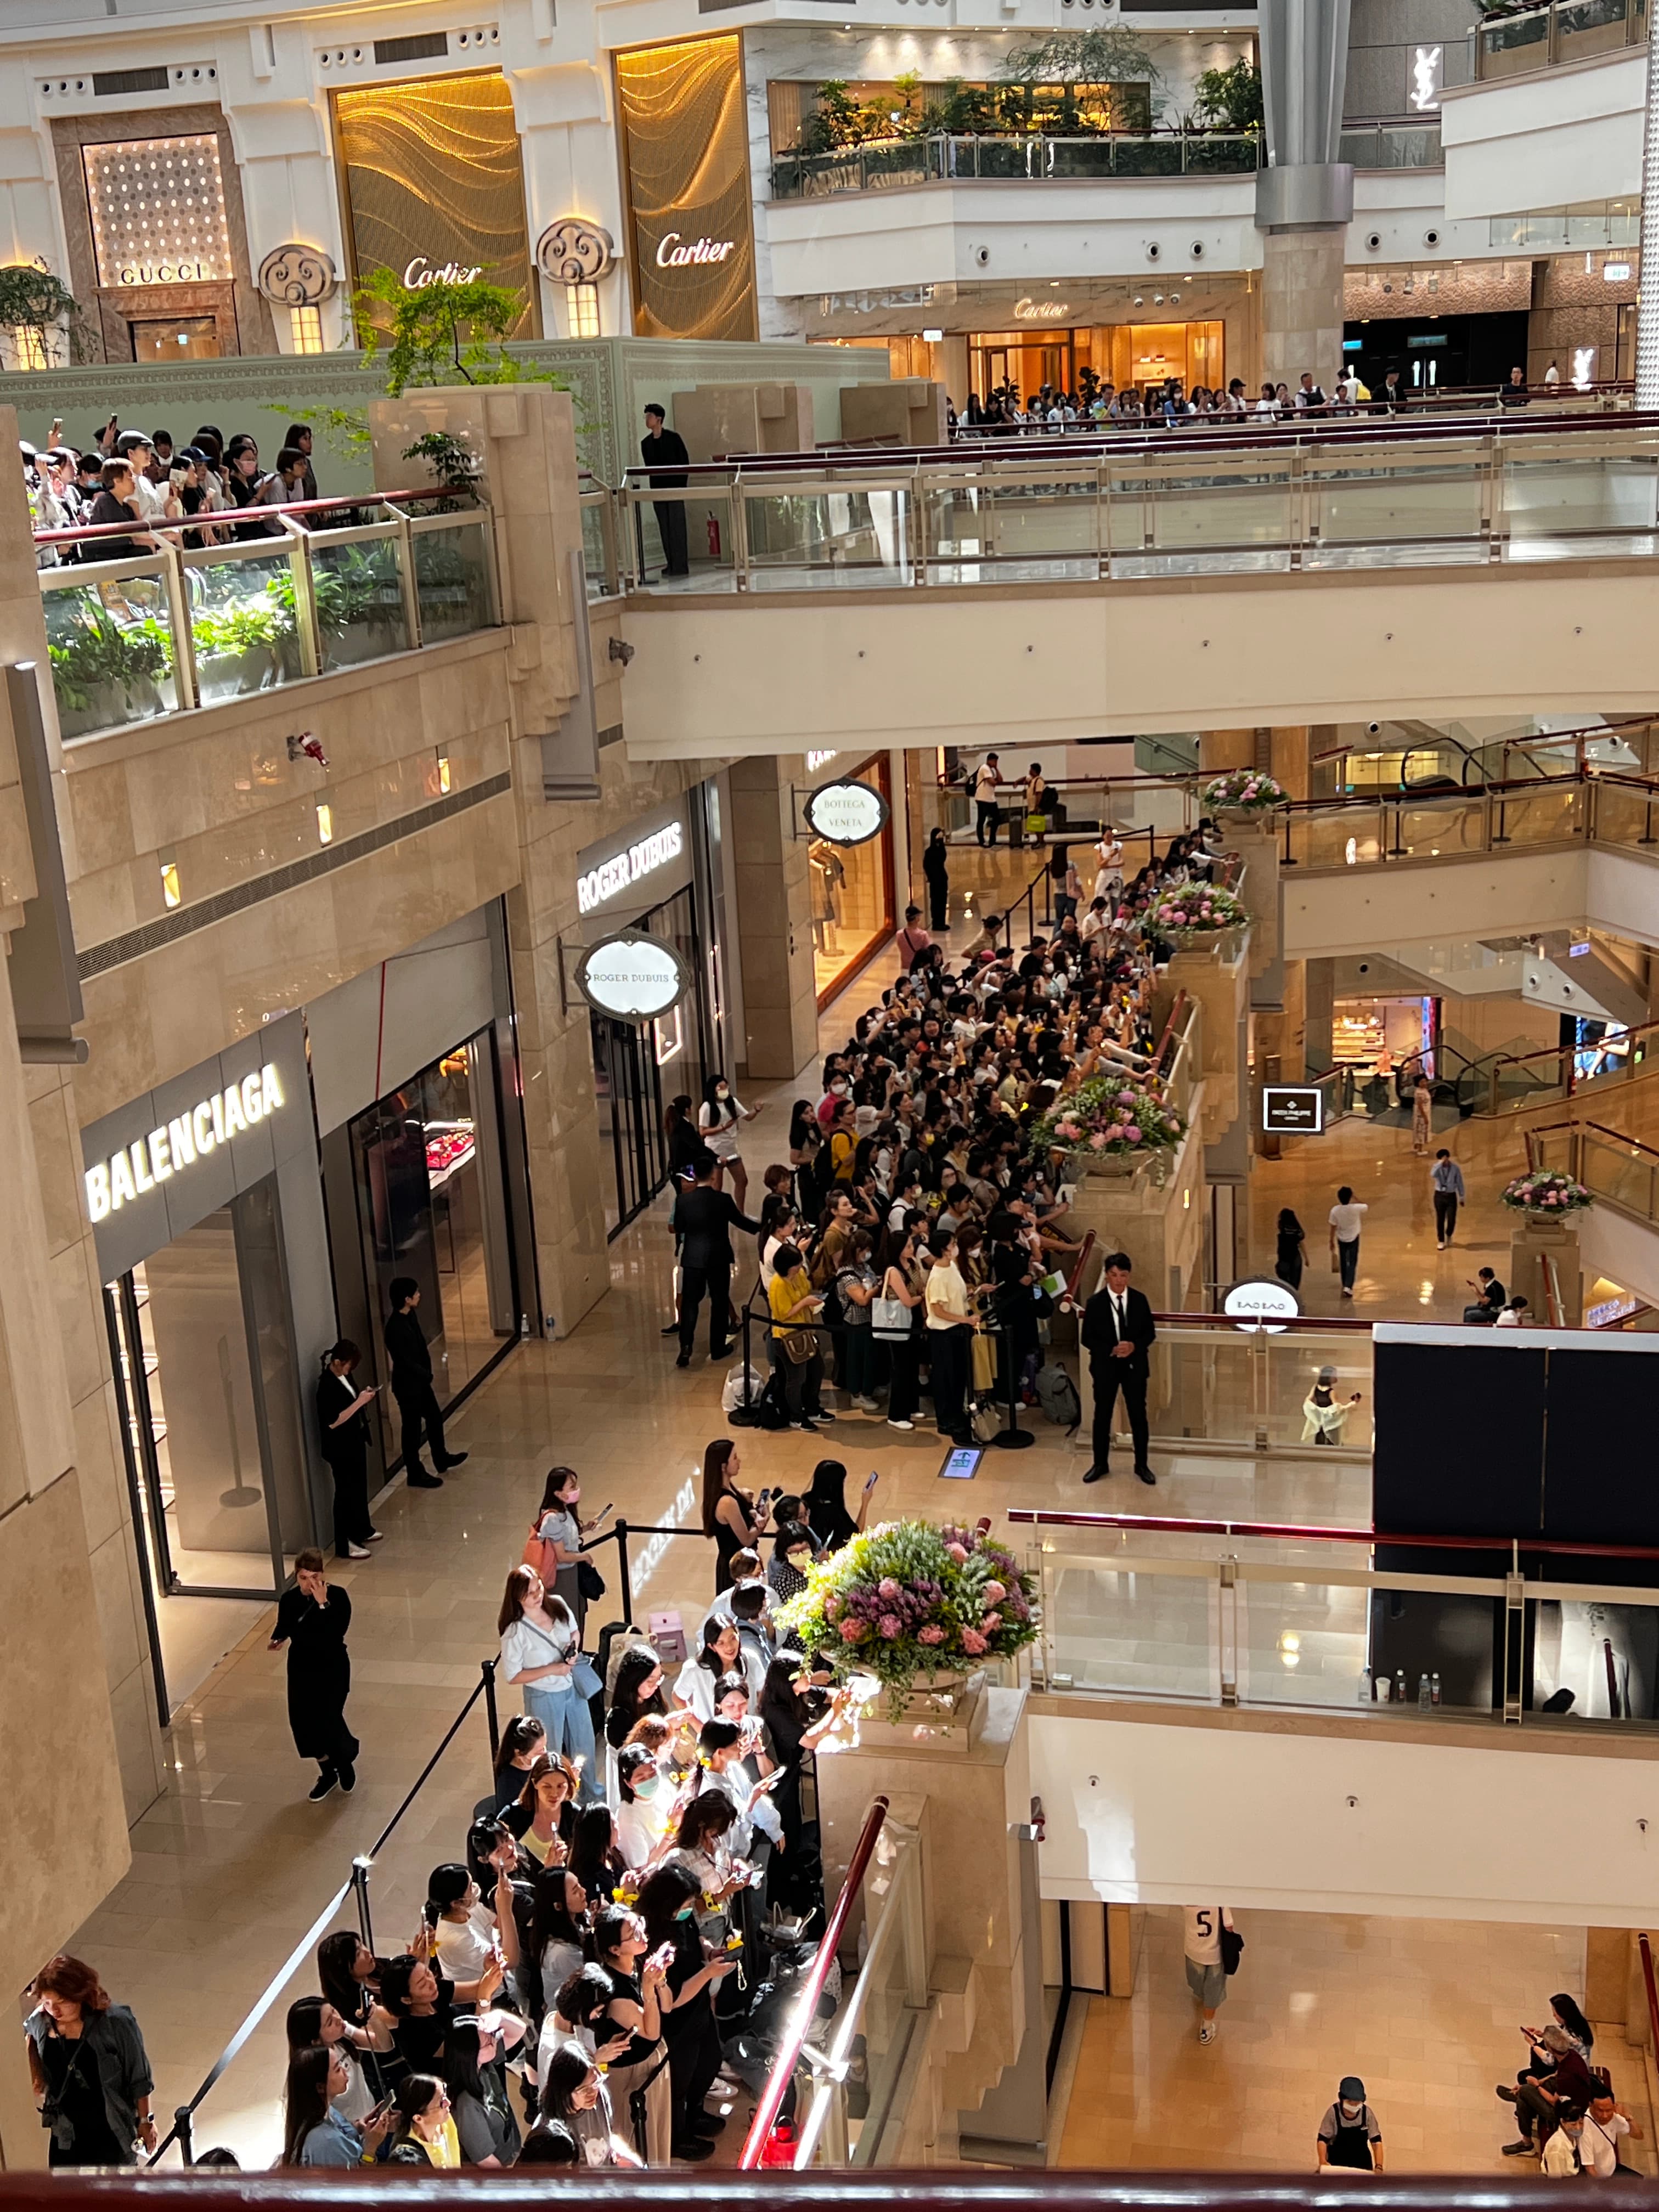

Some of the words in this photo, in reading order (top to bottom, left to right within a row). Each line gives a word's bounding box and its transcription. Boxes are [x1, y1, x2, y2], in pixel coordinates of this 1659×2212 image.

[657, 232, 734, 268] Cartier
[121, 263, 201, 284] GUCCI
[404, 257, 482, 289] Cartier
[1015, 298, 1068, 318] Cartier
[824, 800, 865, 809] BOTTEGA
[829, 818, 862, 827] VENETA
[577, 853, 631, 914] ROGER
[629, 821, 681, 881] DUBUIS
[593, 974, 629, 982] ROGER
[631, 974, 669, 983] DUBUIS
[84, 1063, 284, 1223] BALENCIAGA
[1197, 1911, 1212, 1937] 5
